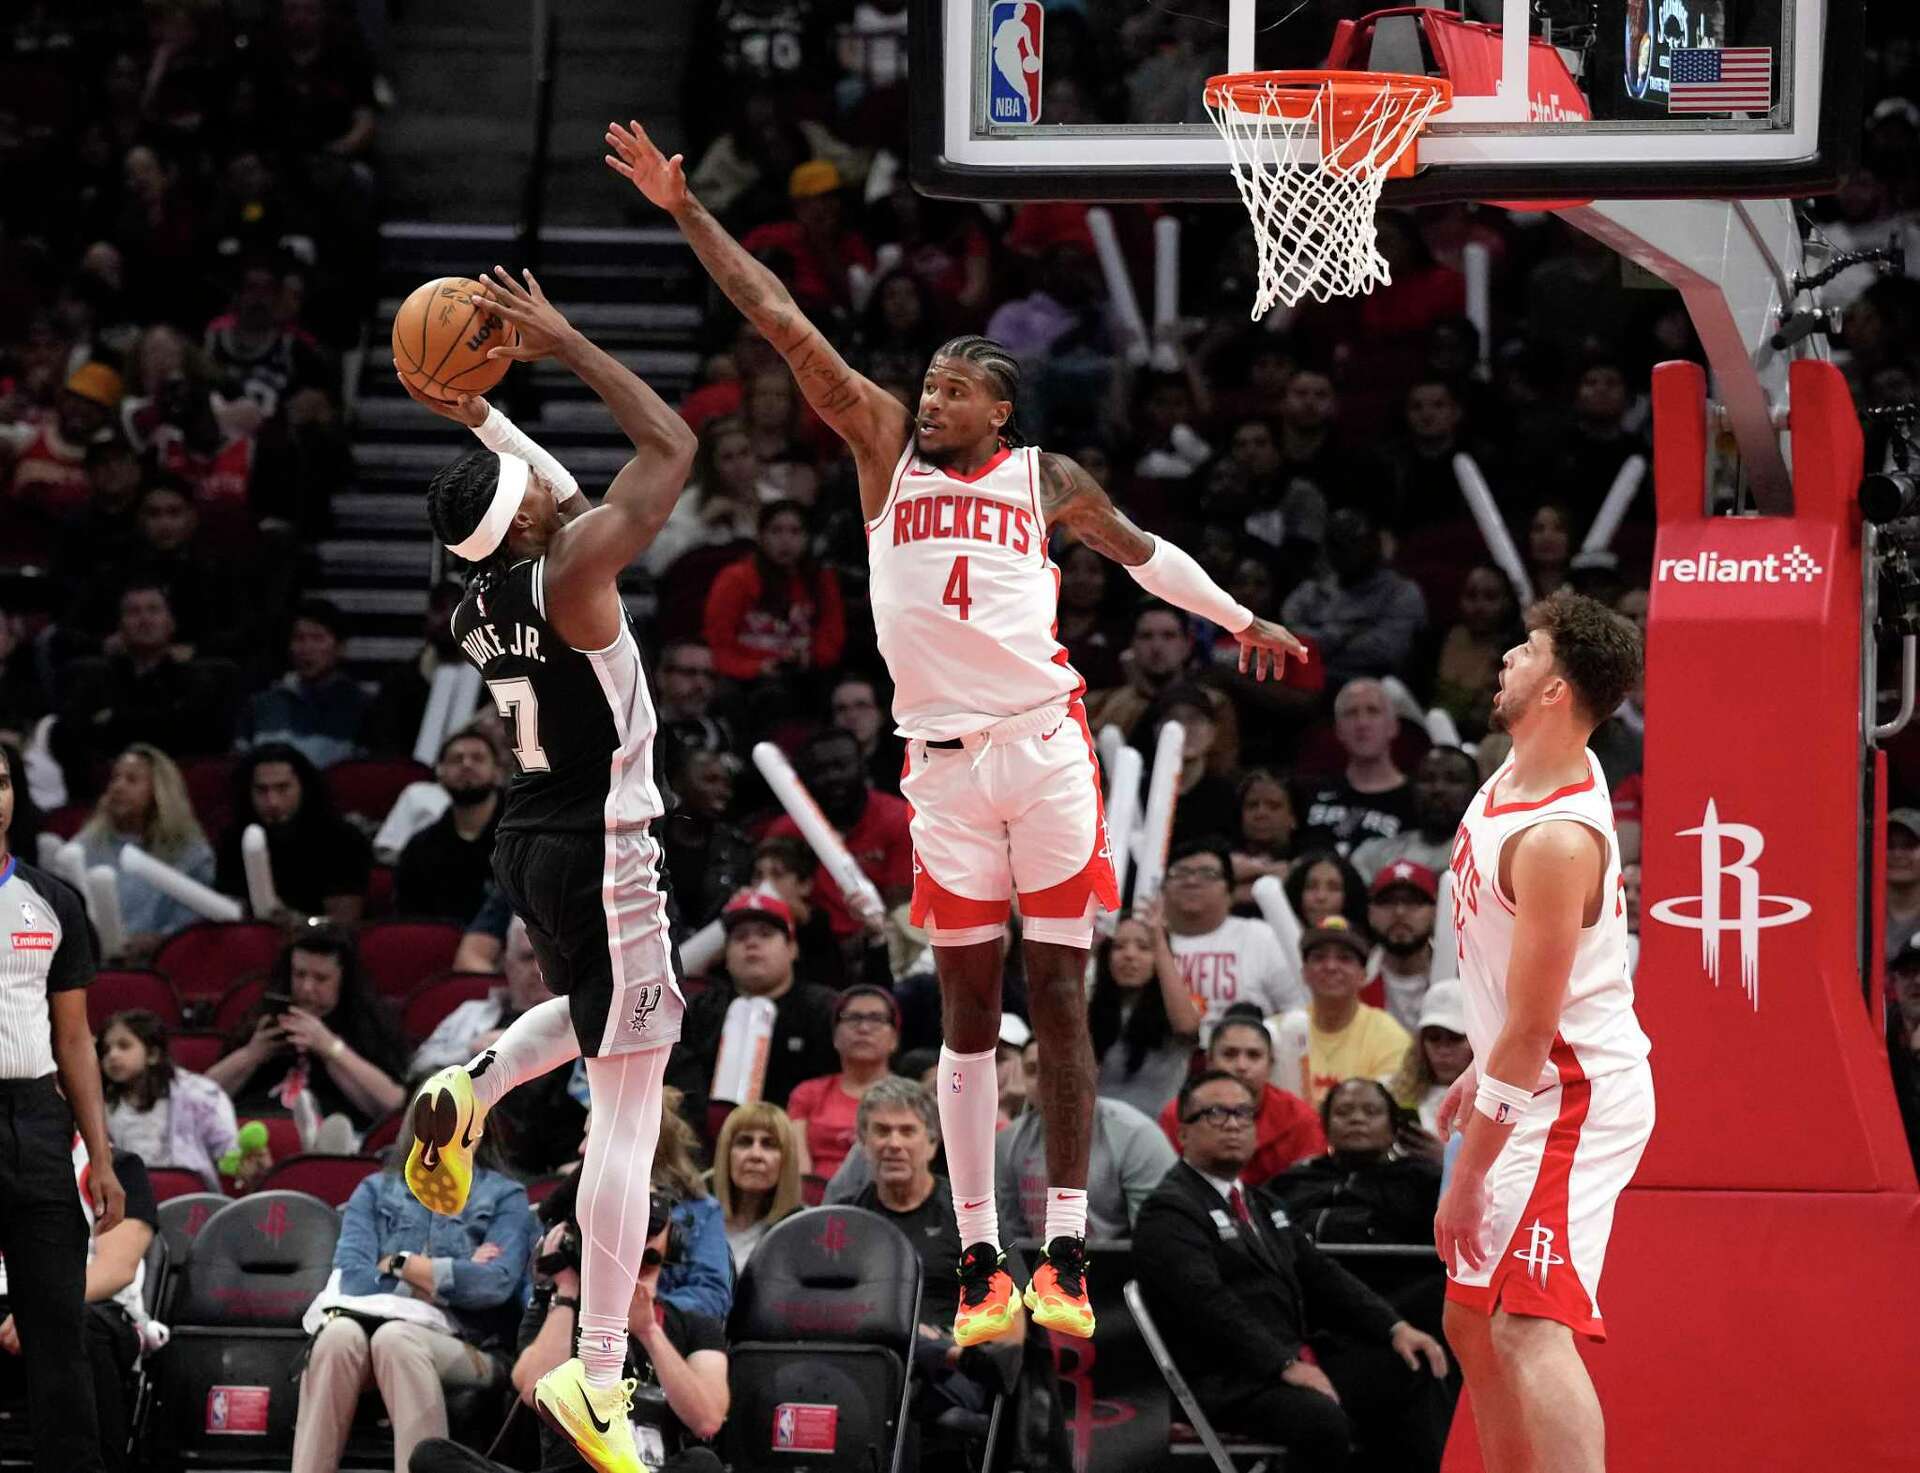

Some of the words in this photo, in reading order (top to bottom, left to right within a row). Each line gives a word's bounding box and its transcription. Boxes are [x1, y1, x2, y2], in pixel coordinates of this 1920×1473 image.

[995, 97, 1020, 117] NBA
[893, 495, 1032, 555] ROCKETS
[942, 556, 972, 621] 4
[1658, 551, 1780, 583] reliant
[461, 623, 506, 670] DUKE
[510, 622, 546, 663] JR.
[486, 676, 551, 773] 7
